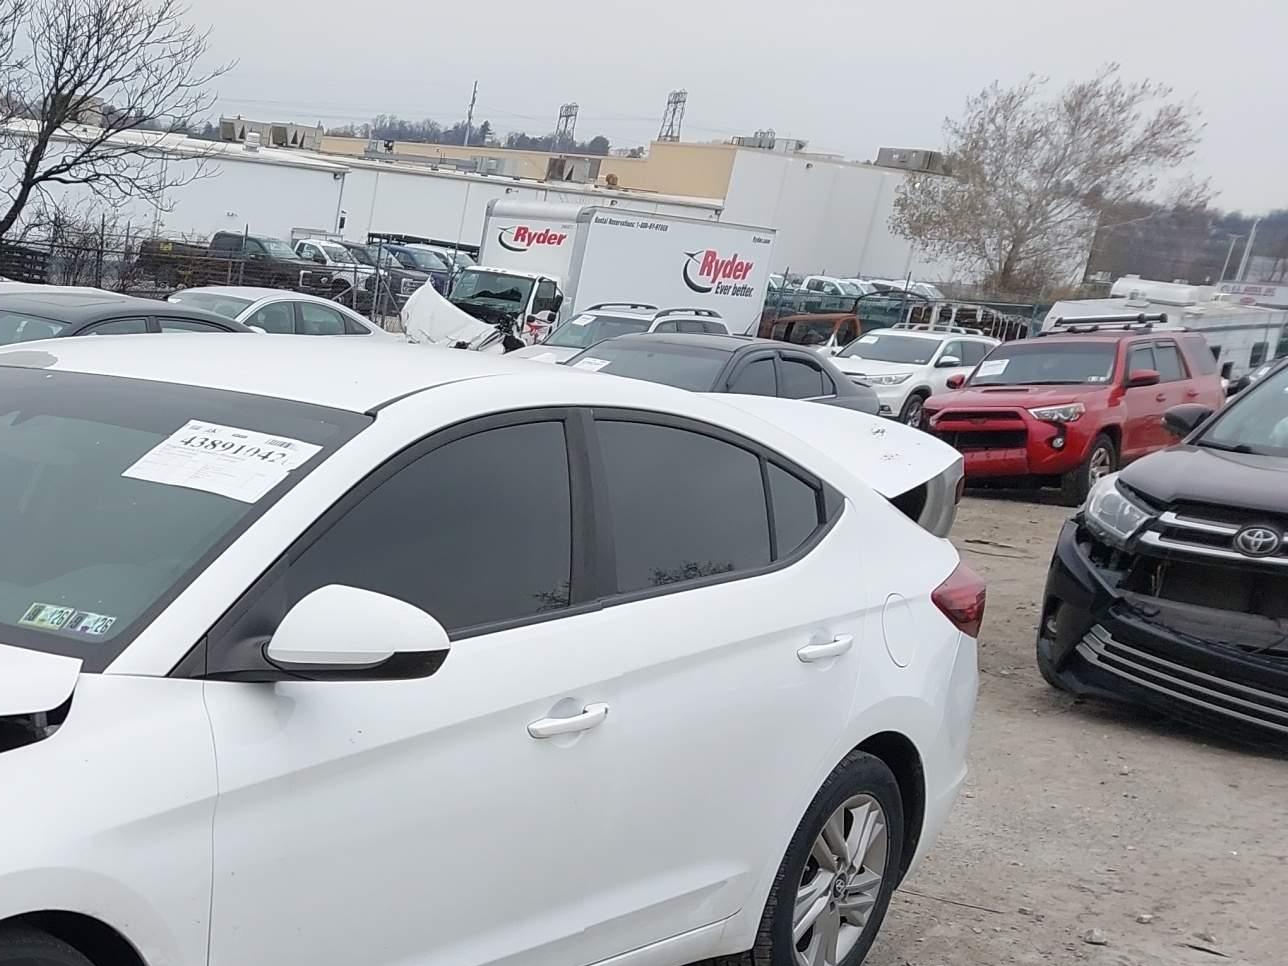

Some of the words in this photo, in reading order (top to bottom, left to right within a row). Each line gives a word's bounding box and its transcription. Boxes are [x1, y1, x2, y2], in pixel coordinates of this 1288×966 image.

[513, 225, 567, 247] Ryder
[698, 249, 754, 284] Ryder
[714, 281, 733, 297] Ever
[180, 435, 287, 463] 43891042
